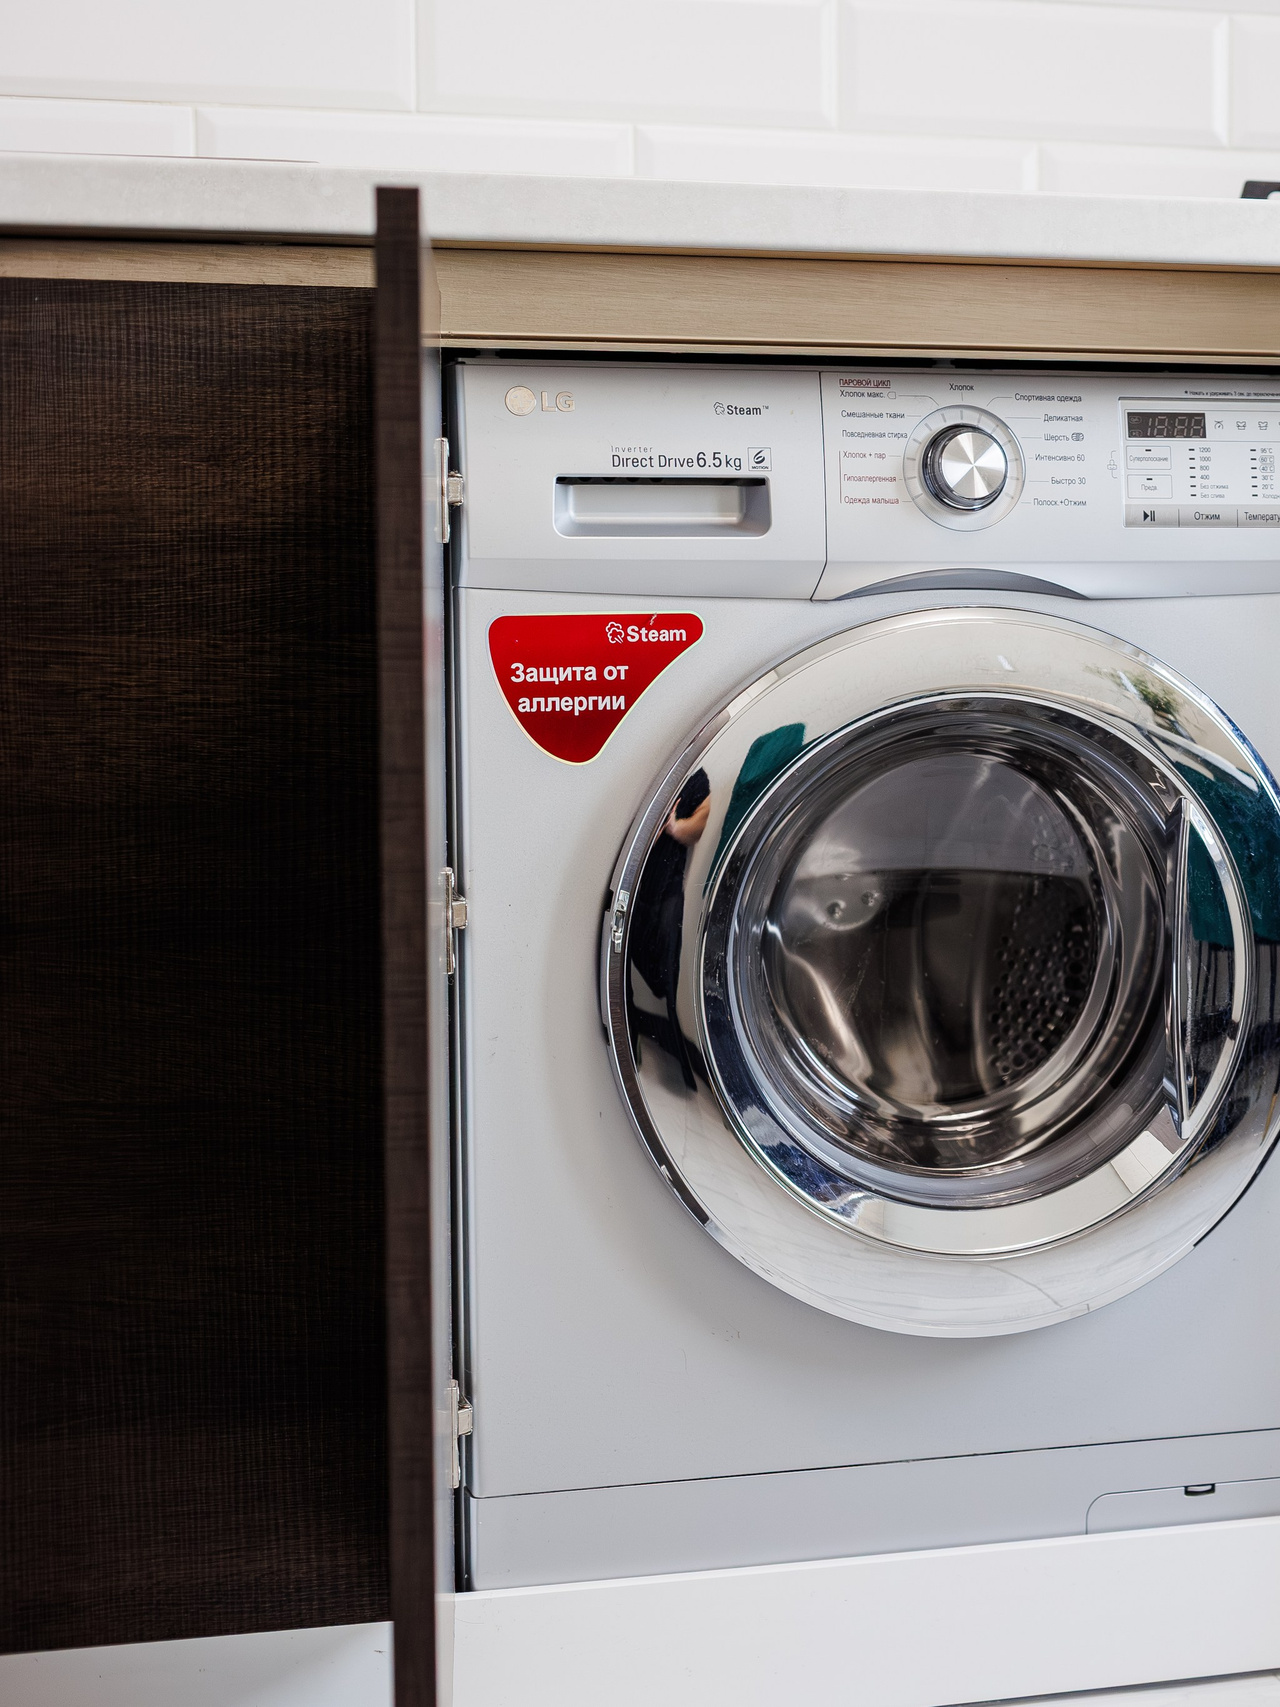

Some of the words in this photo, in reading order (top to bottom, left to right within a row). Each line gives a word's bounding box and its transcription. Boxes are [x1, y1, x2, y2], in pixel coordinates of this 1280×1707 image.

[839, 378, 872, 387] ПАРОВОЙ
[873, 380, 891, 388] ЦИКЛ
[949, 382, 975, 391] Хлопок
[840, 389, 866, 398] Хлопок
[867, 391, 886, 399] макс.
[1014, 392, 1056, 402] Спортивная
[1057, 395, 1082, 403] одежда
[541, 391, 574, 412] LG
[841, 410, 884, 418] Смешанные
[1044, 414, 1083, 422] Деликатная
[842, 430, 886, 439] Повседневная
[887, 432, 908, 440] стирка
[1044, 433, 1070, 442] Шерсть
[611, 445, 653, 453] Inverter
[843, 451, 867, 459] Хлопок
[1035, 454, 1076, 462] Интенсивно
[1076, 454, 1085, 462] 60
[1129, 455, 1169, 463] Суперполоскание
[612, 454, 654, 468] Direct
[658, 455, 694, 468] Drive
[696, 452, 722, 468] 6.5
[725, 455, 742, 471] kg
[844, 474, 897, 483] Гипоаллергенная
[1051, 477, 1077, 486] Быстро
[1077, 477, 1086, 485] 30
[844, 496, 870, 505] Одежда
[1194, 511, 1221, 521] Отжим
[626, 626, 687, 642] Steam
[510, 663, 597, 685] Защита
[603, 666, 629, 680] от
[518, 695, 625, 716] аллергии
